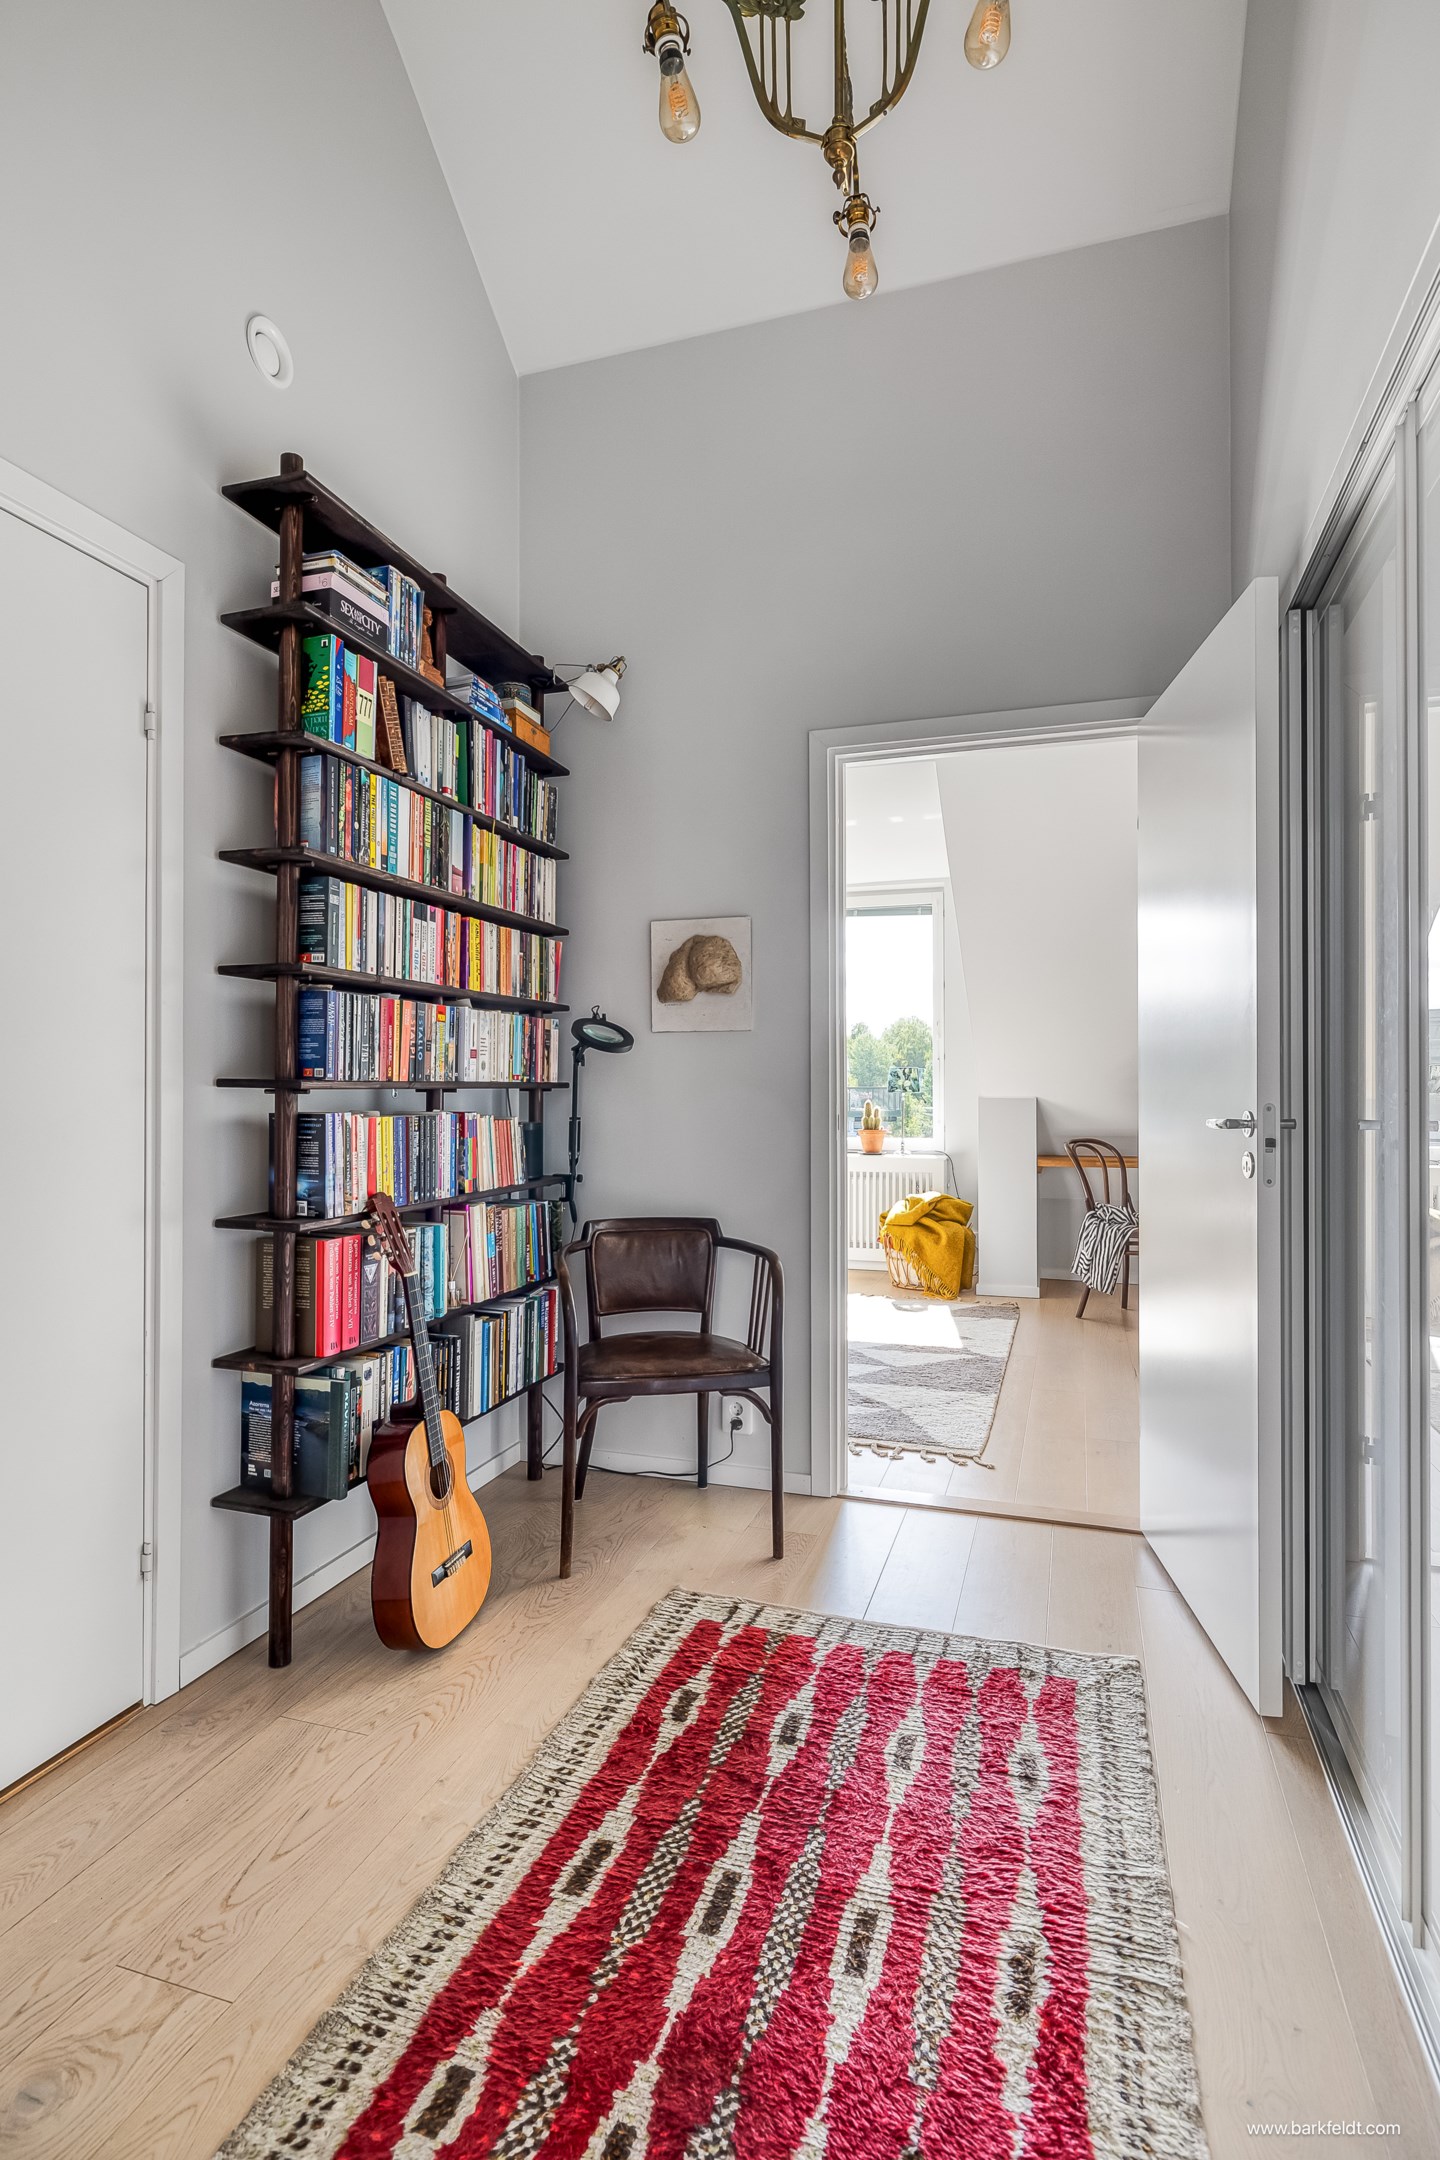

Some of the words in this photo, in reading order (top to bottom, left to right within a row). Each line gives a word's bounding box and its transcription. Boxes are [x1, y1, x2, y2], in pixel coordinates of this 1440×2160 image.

[340, 600, 354, 618] SEX
[362, 615, 381, 635] CITY
[359, 693, 373, 720] 777
